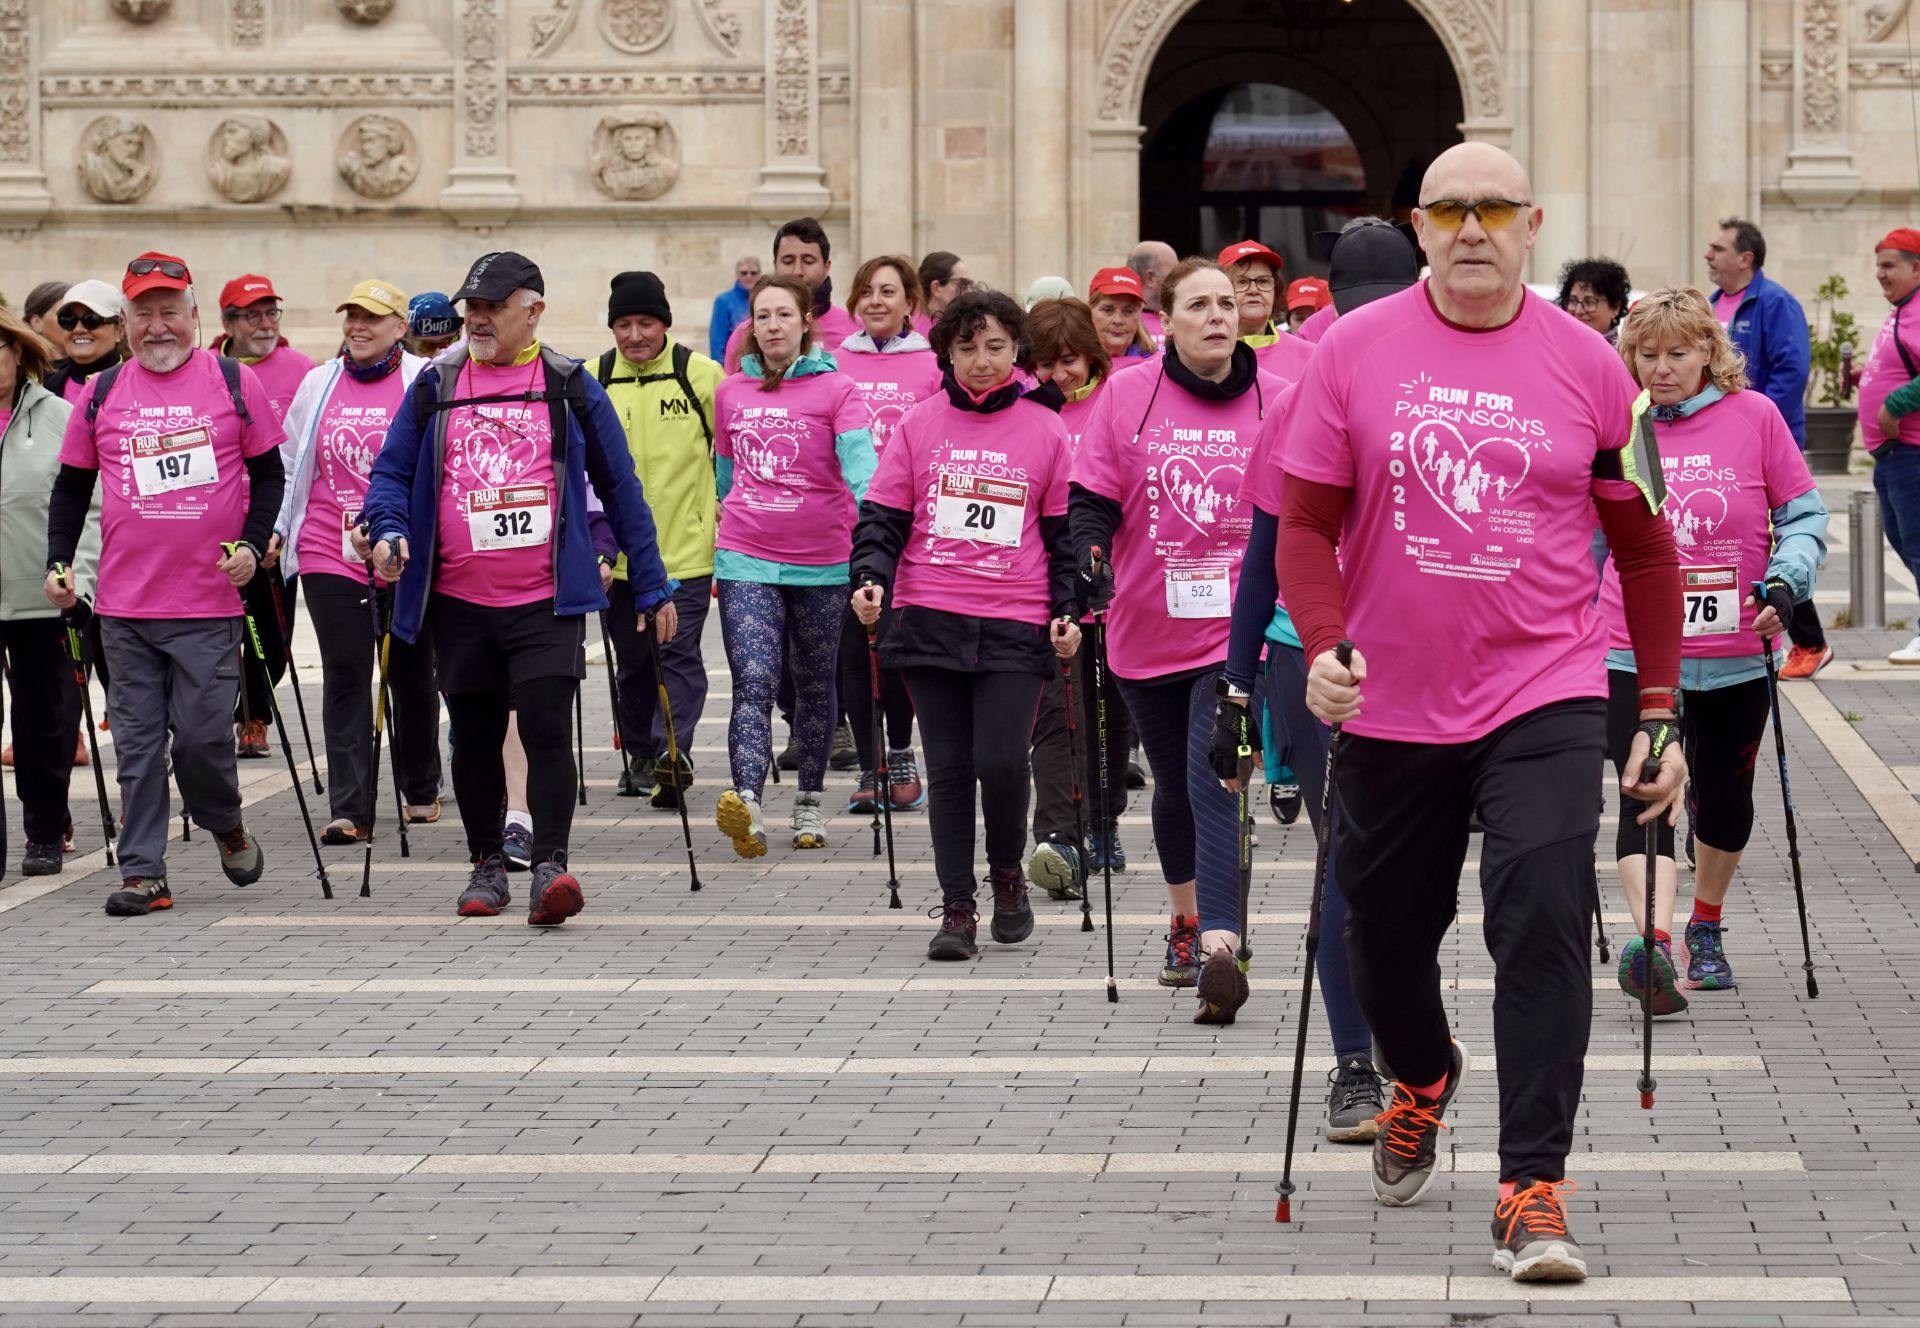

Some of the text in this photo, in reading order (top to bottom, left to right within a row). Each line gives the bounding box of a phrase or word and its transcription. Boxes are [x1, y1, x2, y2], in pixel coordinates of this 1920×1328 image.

[422, 319, 449, 333] Buff
[877, 382, 898, 391] FOR
[1429, 386, 1514, 412] RUN FOR
[140, 406, 192, 418] RUN FOR
[341, 408, 386, 417] RUN FOR
[478, 406, 532, 420] RUN FOR
[742, 408, 788, 419] RUN FOR
[1395, 400, 1546, 436] PARKINSON'S
[119, 415, 214, 430] PARKINSON'S
[325, 416, 393, 428] PARKINSON
[728, 418, 808, 431] PARKINSON'S
[136, 436, 160, 450] RUN
[1173, 428, 1237, 443] RUN FOR
[950, 450, 1008, 464] RUN FOR
[1148, 442, 1252, 459] PARKINSON'
[119, 438, 130, 496] 2025
[156, 453, 192, 480] 197
[322, 434, 336, 490] 2025
[1660, 454, 1712, 469] UN FOR
[929, 462, 1028, 480] PARKINSON'S
[1664, 468, 1736, 483] KINSON'S
[947, 474, 975, 490] RUN
[1388, 431, 1406, 532] 2025
[474, 490, 500, 502] RUN
[1146, 466, 1160, 539] 2025
[964, 502, 996, 530] 20
[1490, 508, 1536, 519] UN ESFUERZO
[494, 511, 533, 538] 312
[1172, 570, 1192, 581] RUN
[1698, 576, 1734, 584] PARKINSON
[1191, 584, 1213, 598] 522
[1683, 596, 1718, 623] 76
